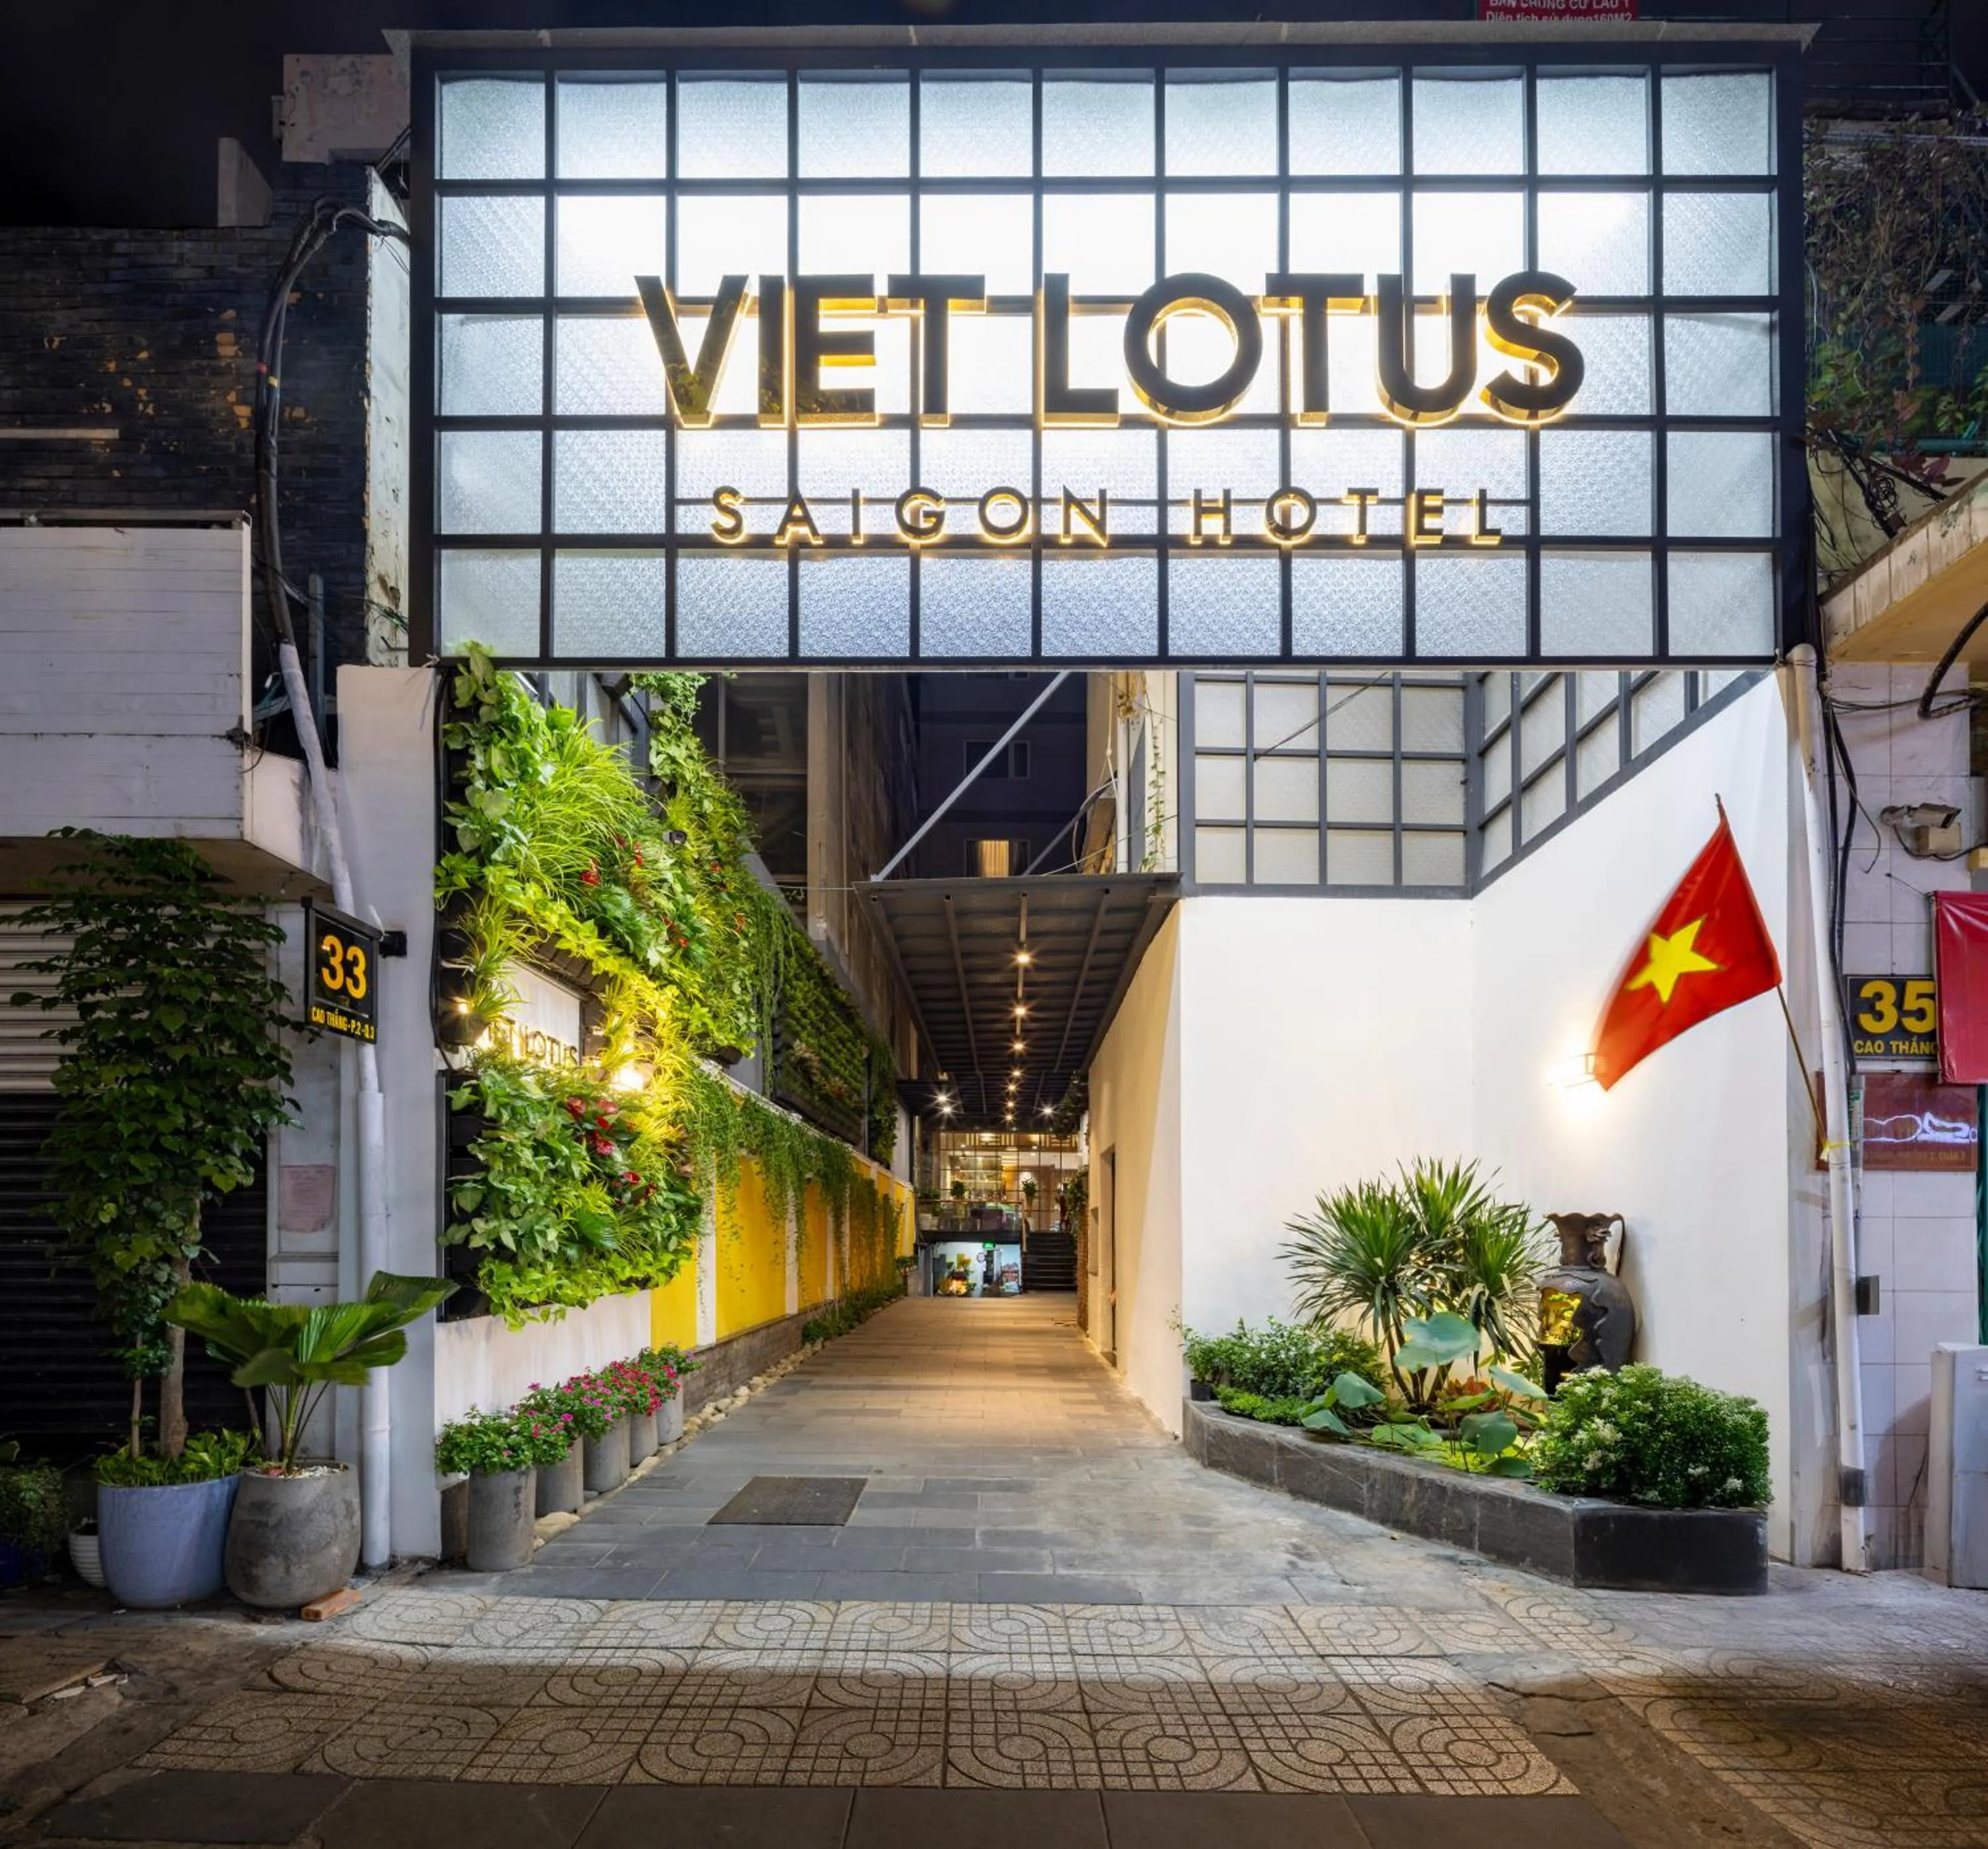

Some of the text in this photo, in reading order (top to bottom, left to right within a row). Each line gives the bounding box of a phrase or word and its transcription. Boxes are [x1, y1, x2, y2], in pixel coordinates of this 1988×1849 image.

[634, 271, 1584, 427] VIET LOTUS
[710, 484, 1502, 547] SAIGON HOTEL
[321, 934, 367, 999] 33
[311, 1006, 325, 1024] CAO
[1858, 980, 1937, 1034] 35
[1855, 1039, 1885, 1054] CAO
